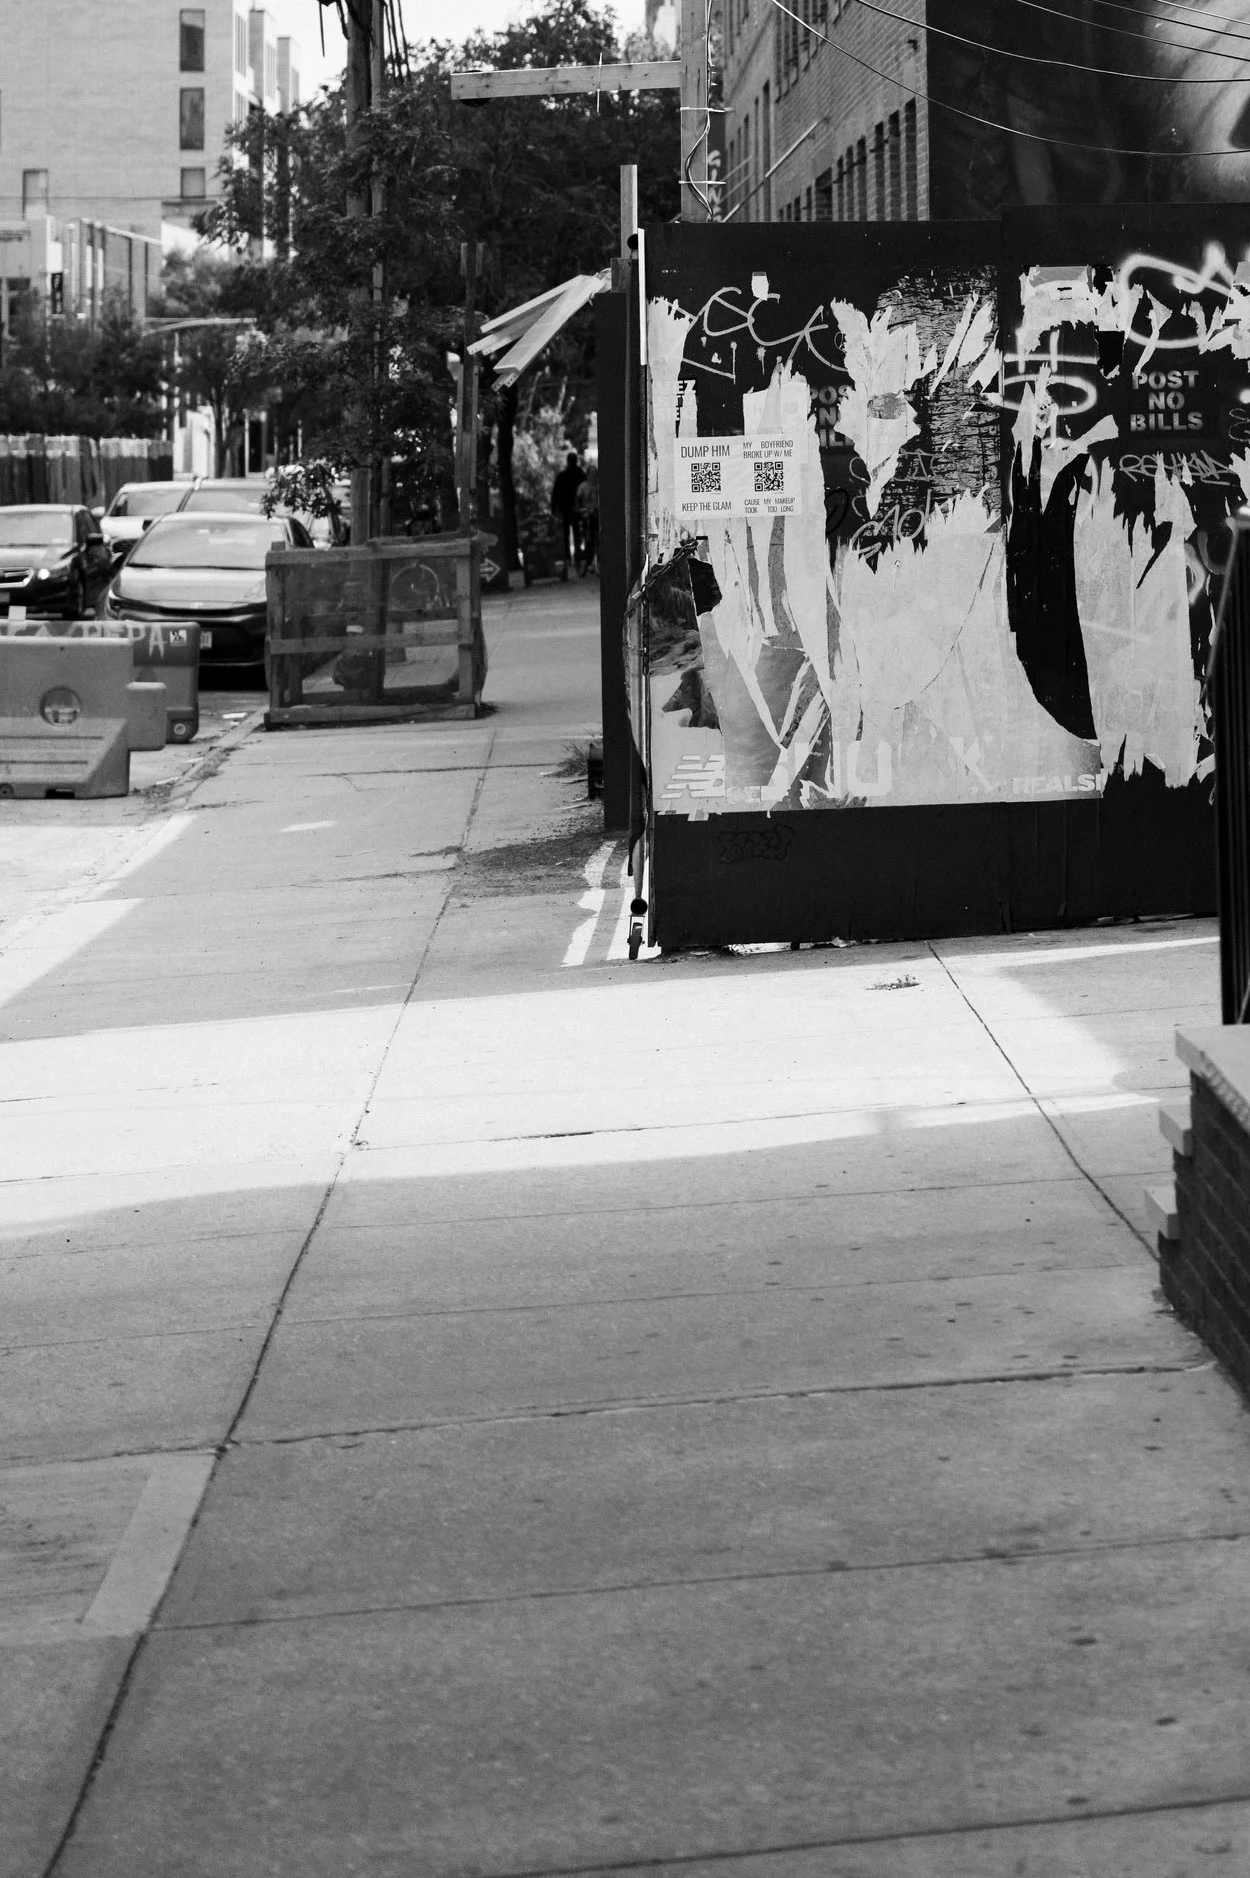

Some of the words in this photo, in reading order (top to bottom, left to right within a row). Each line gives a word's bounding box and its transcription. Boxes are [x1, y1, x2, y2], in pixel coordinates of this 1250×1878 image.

[1132, 370, 1199, 389] POST
[1148, 391, 1185, 410] NO
[1130, 411, 1203, 432] BILLS
[761, 440, 793, 448] BOYFRIEND
[681, 445, 709, 458] DUMP
[711, 445, 730, 457] HIM
[783, 449, 792, 457] ME
[682, 503, 698, 511] KEEP
[699, 502, 711, 511] THE
[713, 501, 732, 510] GLAM
